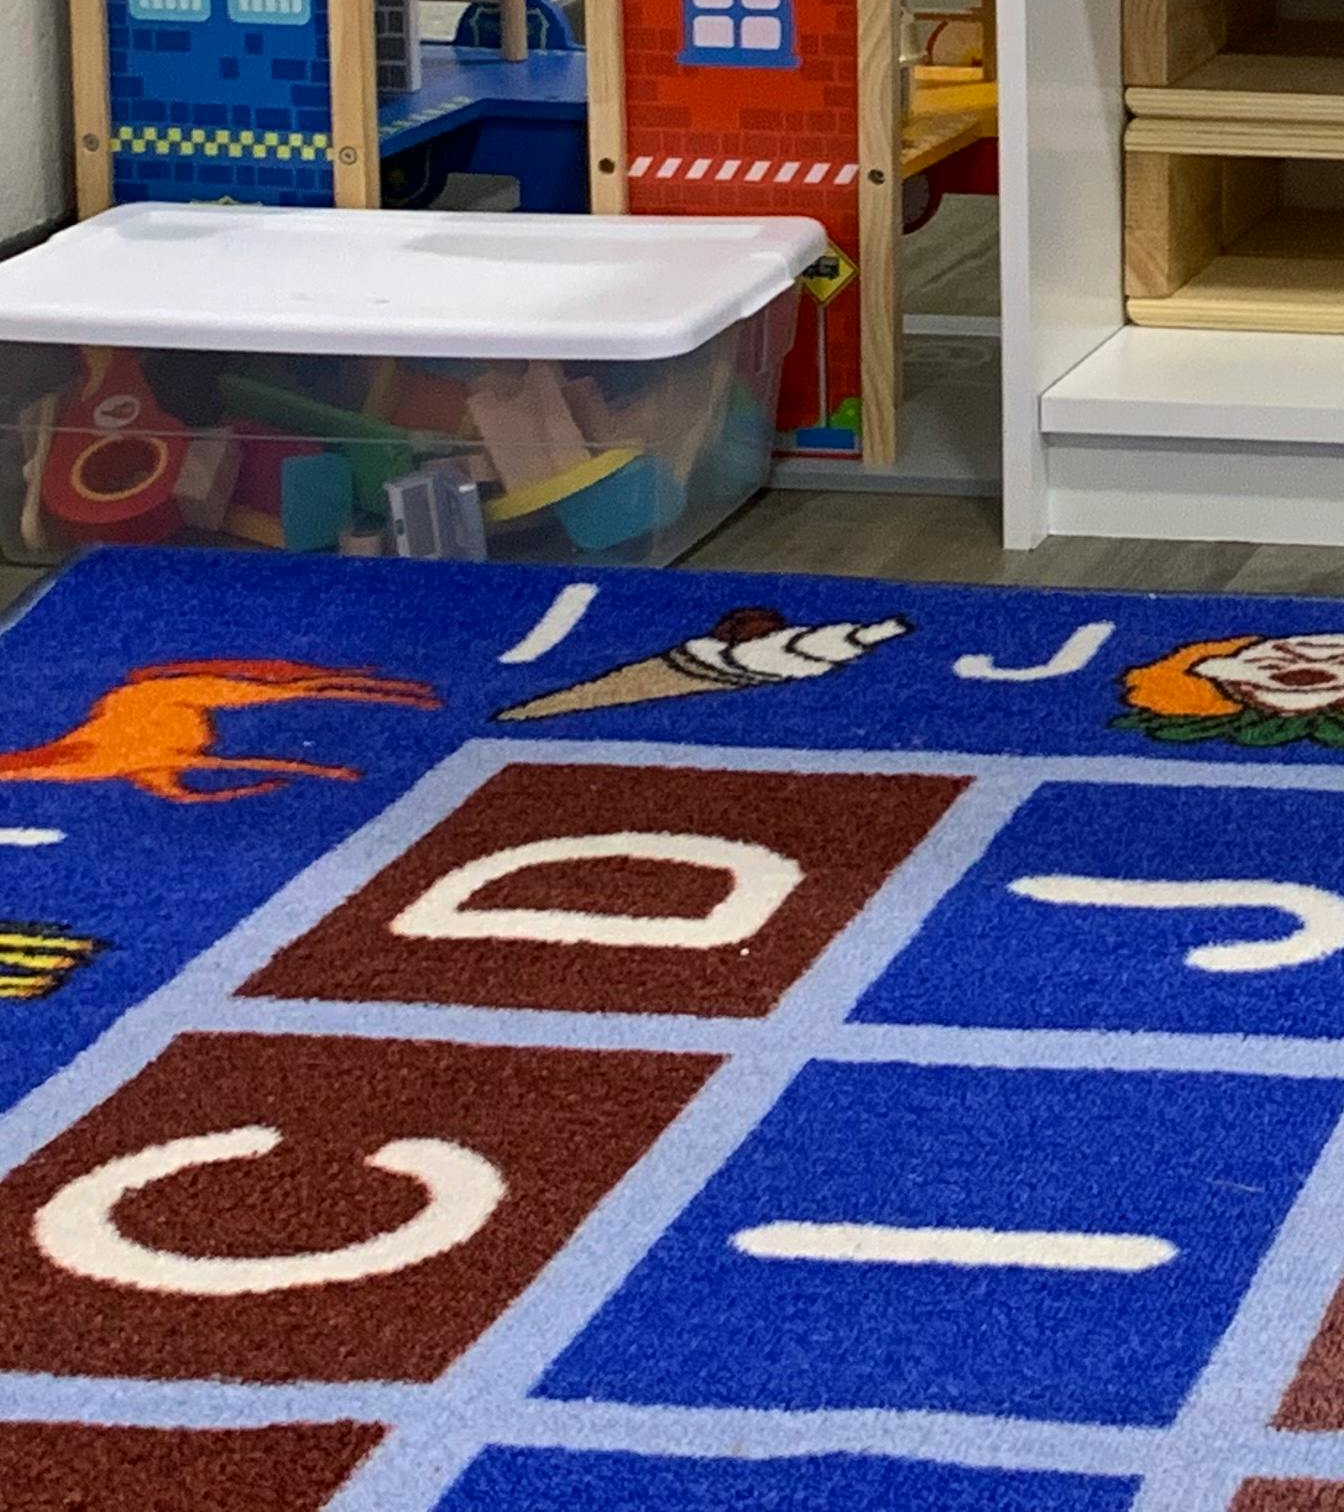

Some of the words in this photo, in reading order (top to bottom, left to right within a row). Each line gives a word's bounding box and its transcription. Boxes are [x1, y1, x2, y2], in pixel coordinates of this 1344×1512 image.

[501, 583, 597, 663] I
[953, 622, 1115, 682] J
[390, 830, 806, 950] D
[33, 1124, 510, 1296] C
